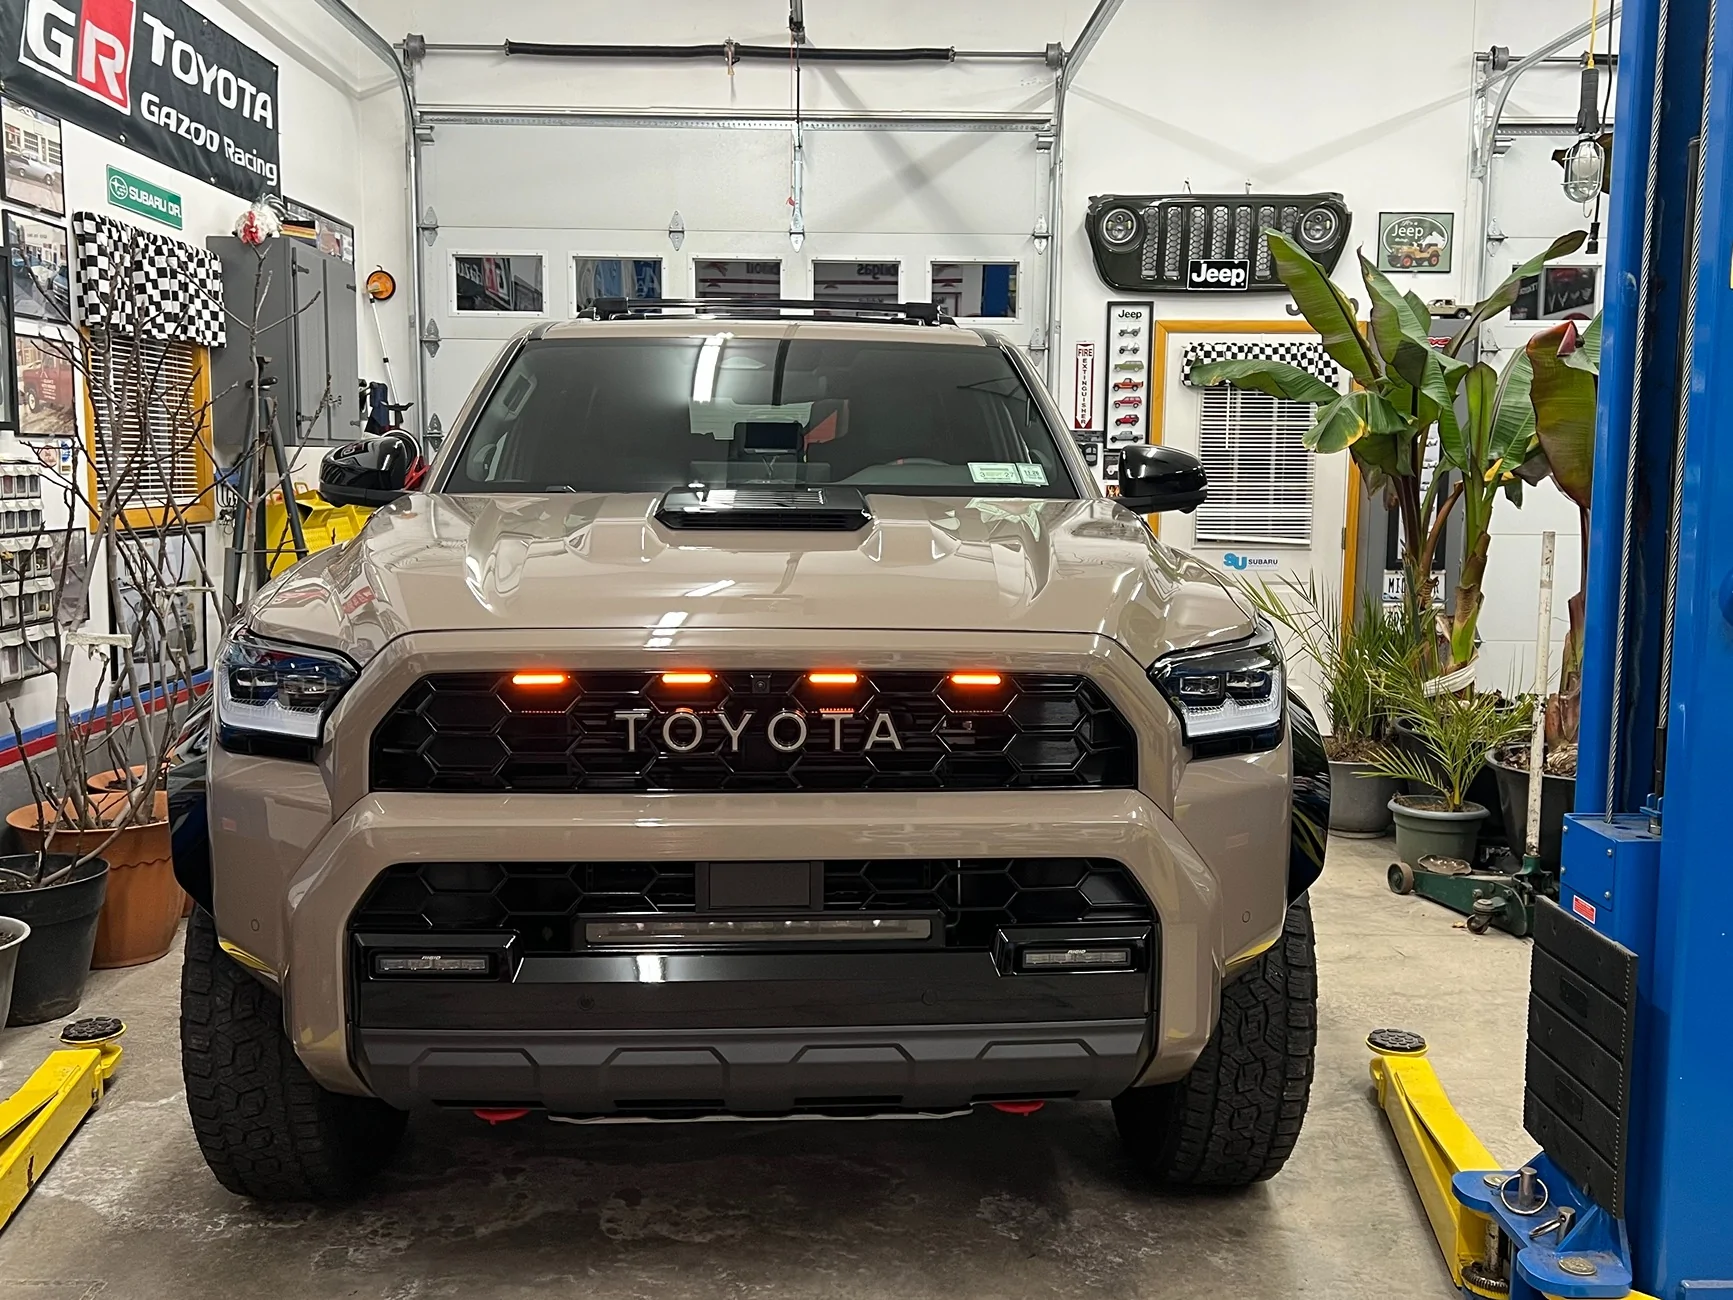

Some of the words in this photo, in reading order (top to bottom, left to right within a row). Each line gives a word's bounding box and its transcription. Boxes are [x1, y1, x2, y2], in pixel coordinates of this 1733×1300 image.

[27, 0, 125, 101] GR
[142, 11, 274, 130] TOYOTA
[140, 91, 221, 153] GAZOO
[223, 135, 278, 187] Racing
[128, 185, 167, 213] SUBARU
[1391, 224, 1424, 240] Jeep
[1117, 309, 1143, 320] Jeep
[1078, 348, 1093, 357] FIRE
[1080, 357, 1088, 425] EXTINGUISHER
[613, 710, 903, 753] TOYOTA
